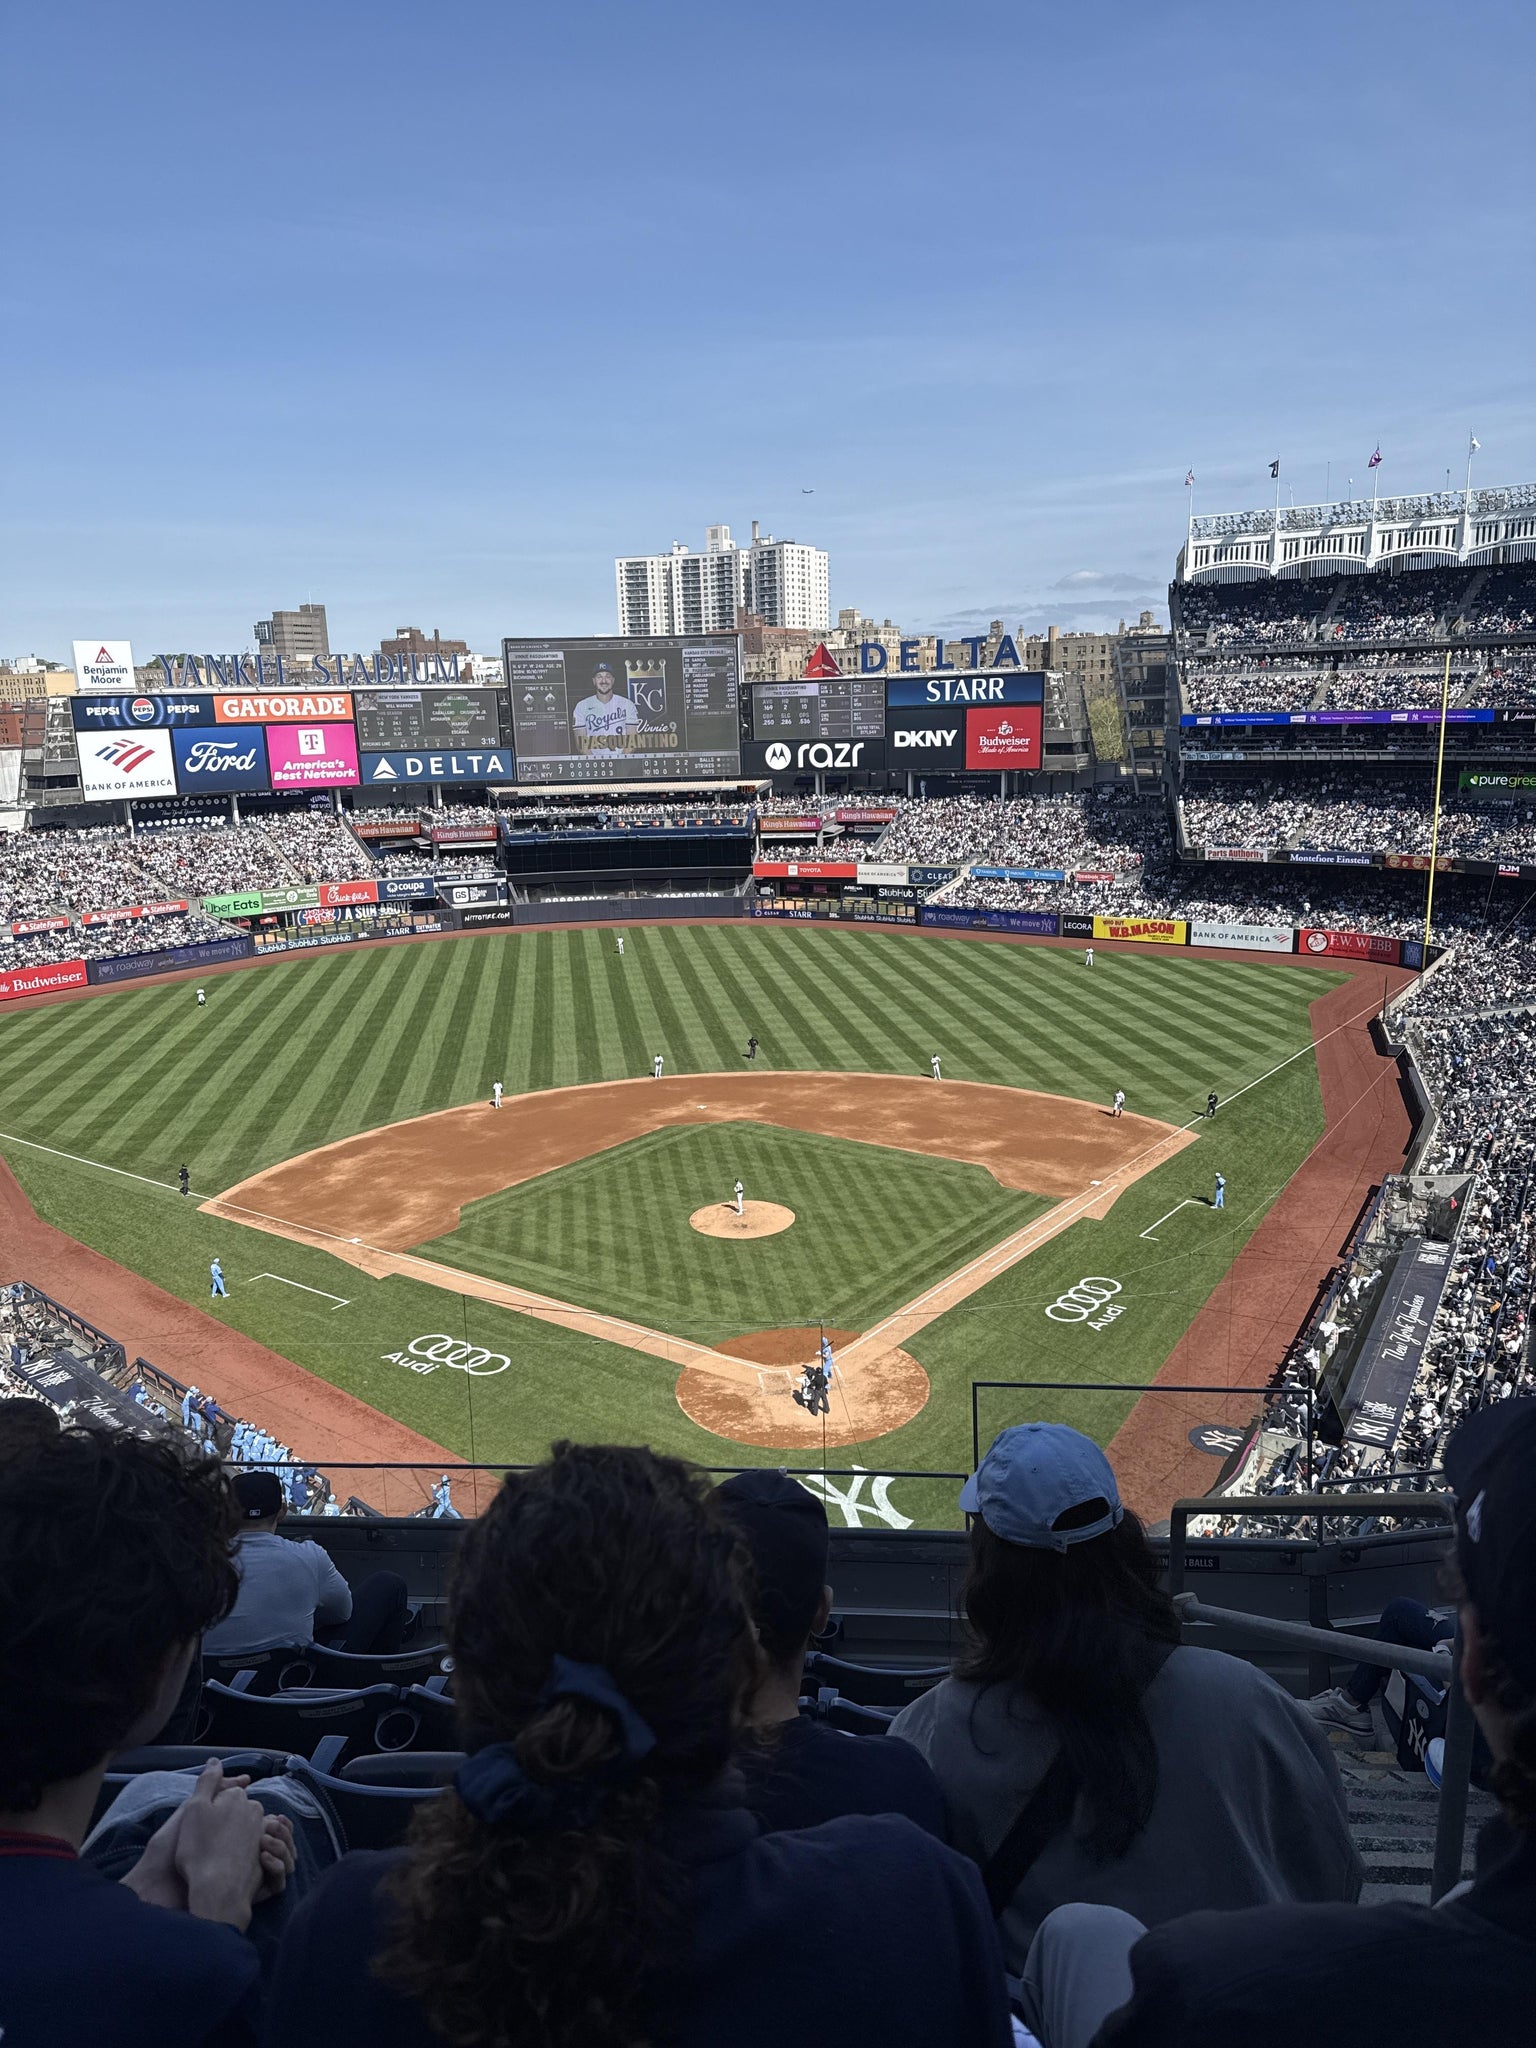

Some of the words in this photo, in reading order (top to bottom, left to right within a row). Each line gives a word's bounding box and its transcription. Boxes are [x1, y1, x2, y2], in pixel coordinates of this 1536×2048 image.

[861, 635, 1022, 673] DELTA
[83, 665, 128, 676] Benjamin
[153, 654, 295, 686] YANKEE
[312, 652, 461, 684] STADIUM
[91, 675, 121, 684] Moore
[631, 682, 663, 712] KC
[926, 677, 1004, 702] STARR
[86, 706, 120, 716] PEPSI
[167, 705, 200, 714] PEPSI
[223, 697, 346, 718] GATORADE
[586, 707, 626, 730] Royals
[636, 719, 669, 734] Vinnie
[669, 722, 677, 732] 9
[304, 734, 318, 750] T
[578, 734, 678, 751] PASQUANTINO
[894, 730, 958, 747] DKNY
[979, 736, 1030, 746] Budweiser
[185, 742, 256, 772] Ford
[798, 742, 864, 768] razr
[998, 746, 1005, 754] of
[283, 759, 345, 770] America's
[406, 755, 504, 776] DELTA
[558, 766, 562, 774] 7
[274, 771, 302, 781] Best
[304, 769, 356, 779] Network
[85, 783, 111, 791] BANK
[129, 779, 172, 788] AMERICA
[842, 812, 860, 820] King's
[358, 827, 379, 835] King's
[437, 830, 457, 839] King's
[1229, 849, 1264, 858] Authority
[1290, 853, 1334, 862] Montefiore
[1336, 856, 1370, 864] Einstein
[1499, 864, 1520, 872] RJM
[398, 882, 424, 891] coupa
[879, 889, 913, 898] StubHub
[206, 903, 231, 914] Uber
[233, 899, 260, 911] Eats
[345, 908, 352, 920] A
[356, 904, 377, 919] SUB
[464, 912, 510, 922] NITTOTIRE.COM
[939, 913, 970, 923] roadway
[387, 927, 410, 936] STARR
[1064, 922, 1092, 930] LEGORA
[257, 944, 286, 954] StubHub
[288, 938, 318, 949] StubHub
[320, 934, 351, 944] StubHub
[1231, 934, 1270, 942] AMERICA
[1330, 934, 1352, 947] F.W.
[1356, 937, 1392, 951] WEBB
[116, 959, 154, 972] roadway
[200, 949, 210, 957] We
[1087, 1304, 1127, 1331] Audi
[1395, 1294, 1428, 1326] Yankees
[1389, 1324, 1422, 1346] York
[1381, 1341, 1408, 1360] New
[380, 1352, 440, 1375] Audi
[80, 1395, 124, 1429] Welcome
[1189, 1559, 1213, 1567] BALLS
[1407, 1718, 1427, 1762] NY
